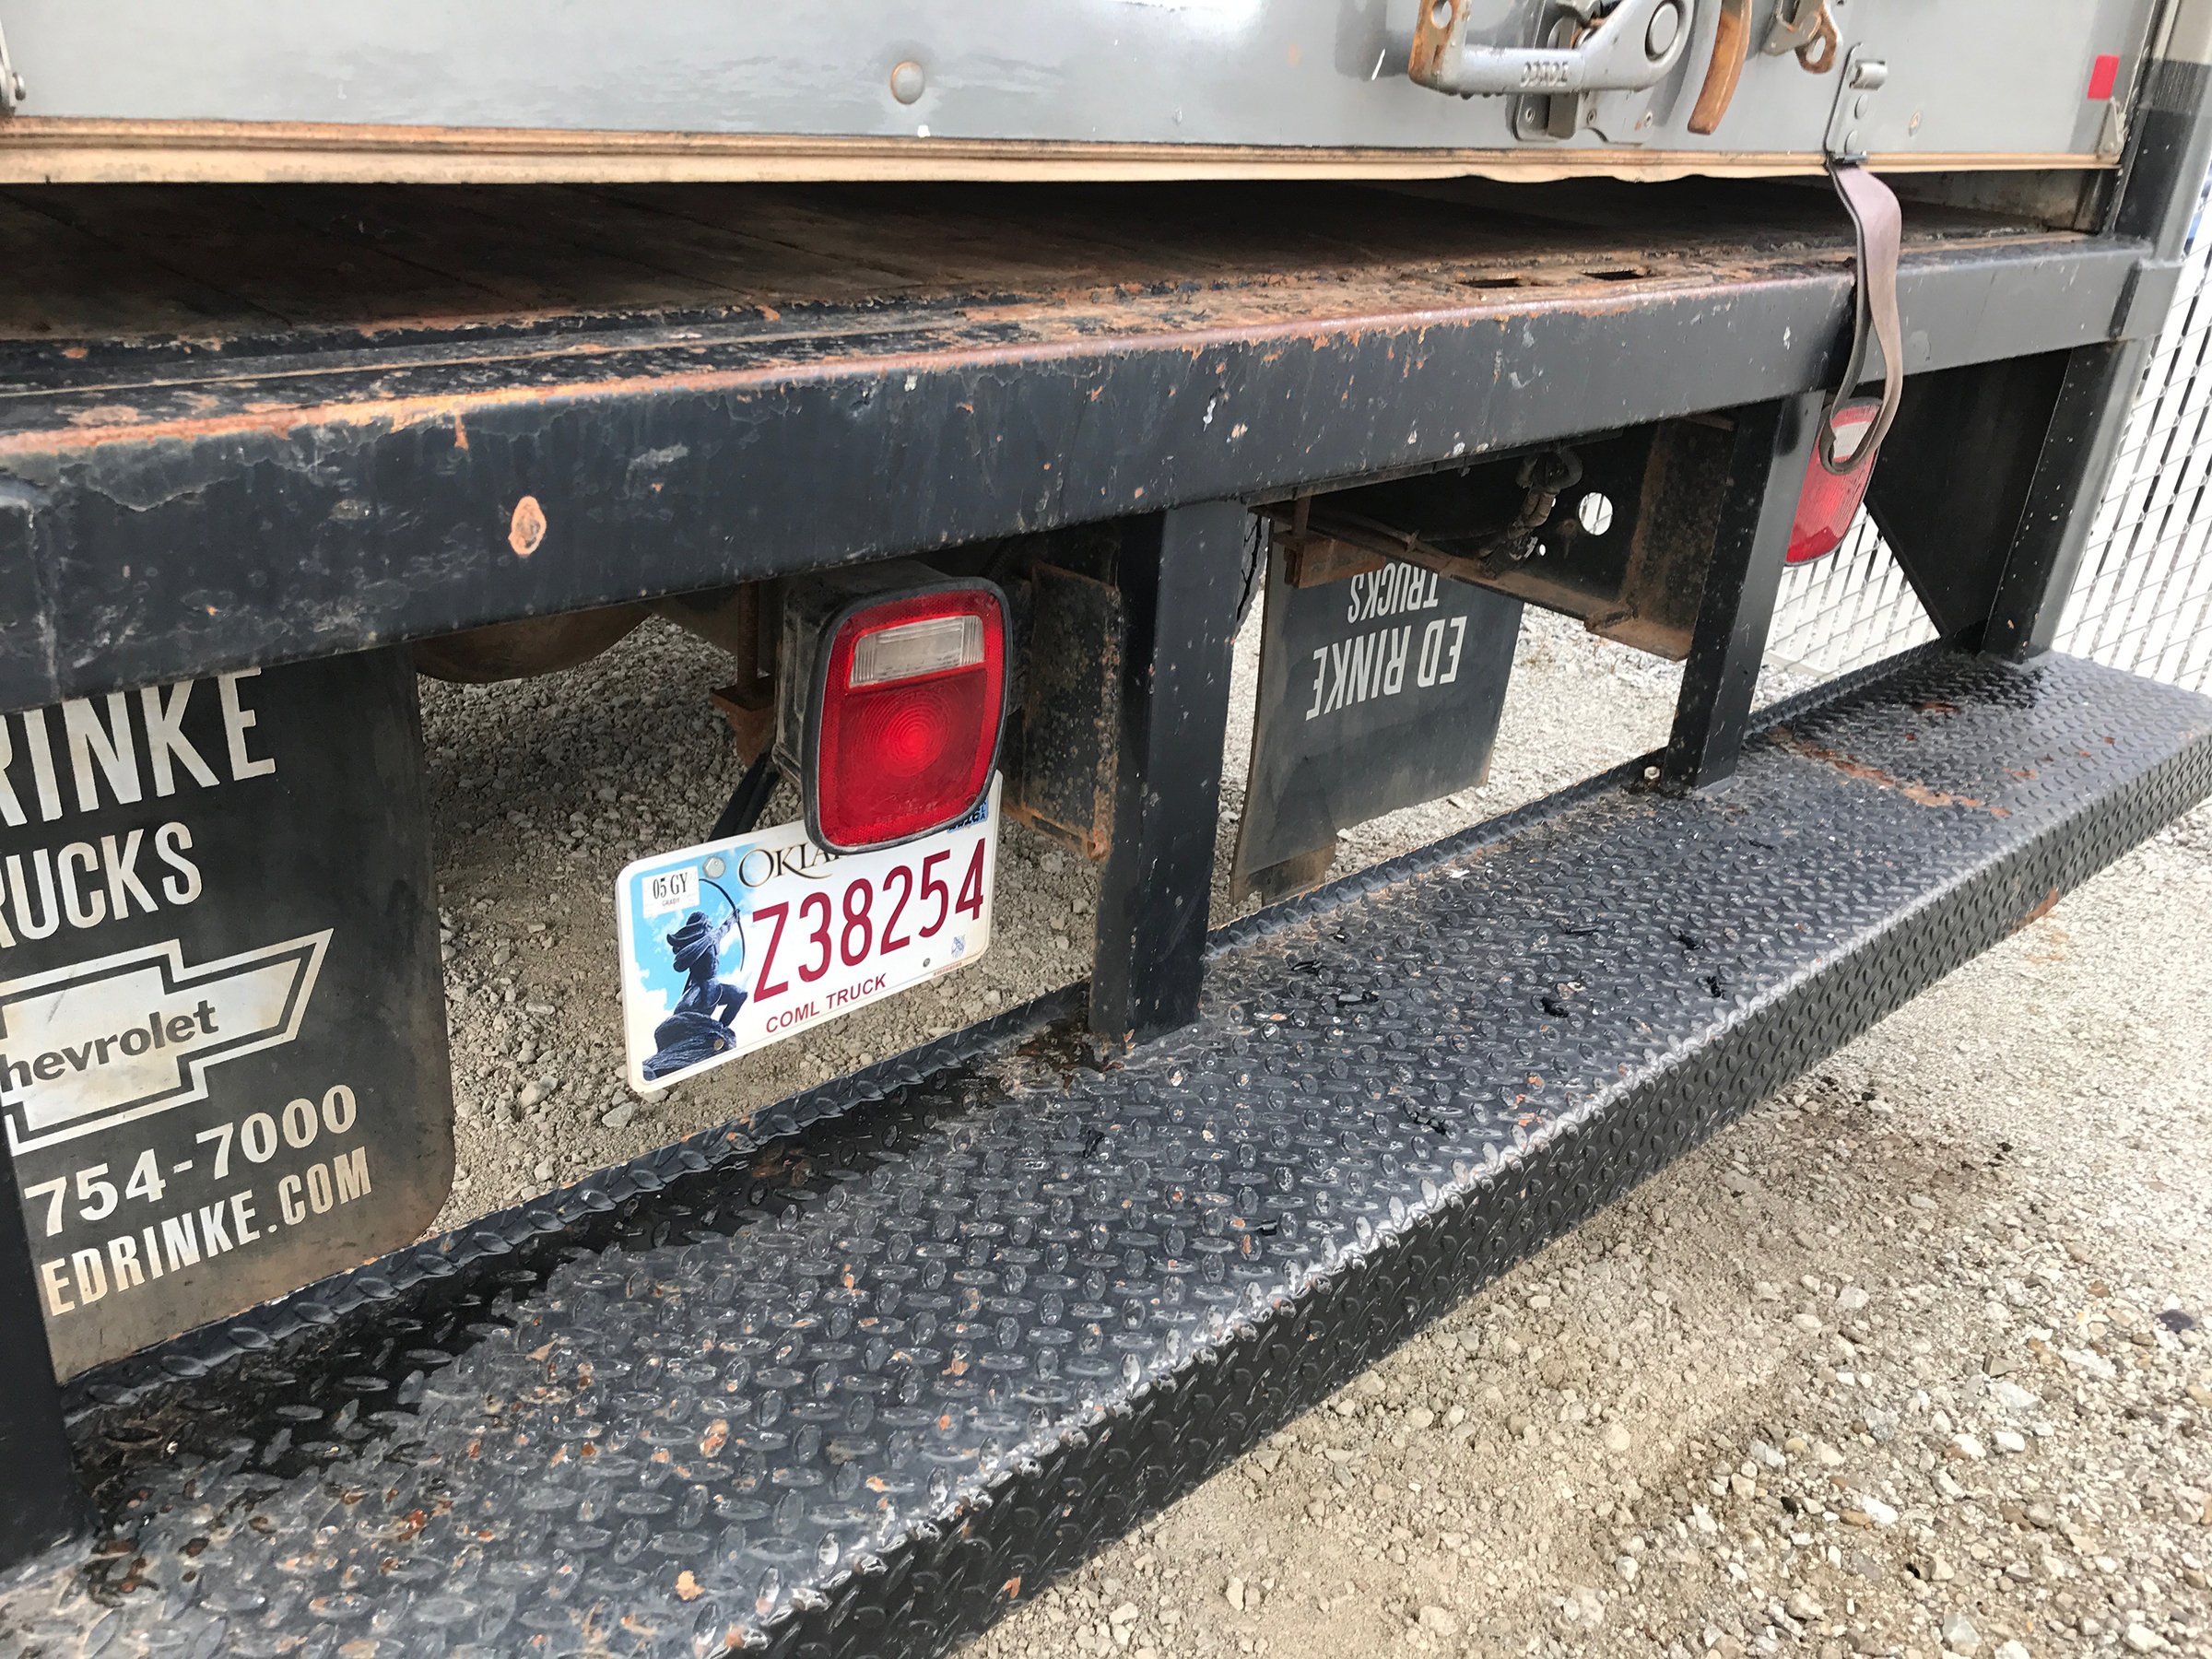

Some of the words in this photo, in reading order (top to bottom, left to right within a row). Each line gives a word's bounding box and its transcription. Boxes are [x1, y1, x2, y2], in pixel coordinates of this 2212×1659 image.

[1347, 562, 1439, 624] TRUCKS
[1306, 625, 1411, 721] RINKE
[1418, 616, 1467, 688] ED
[0, 821, 202, 948] UCKS
[653, 877, 666, 900] 05
[670, 872, 688, 895] GY
[738, 843, 840, 888] OKLA
[752, 838, 985, 1003] Z38254
[766, 1003, 820, 1033] COML
[827, 973, 887, 1007] TRUCK
[25, 1084, 358, 1238] 754-7000
[41, 1146, 371, 1316] EDRINKE.COM
